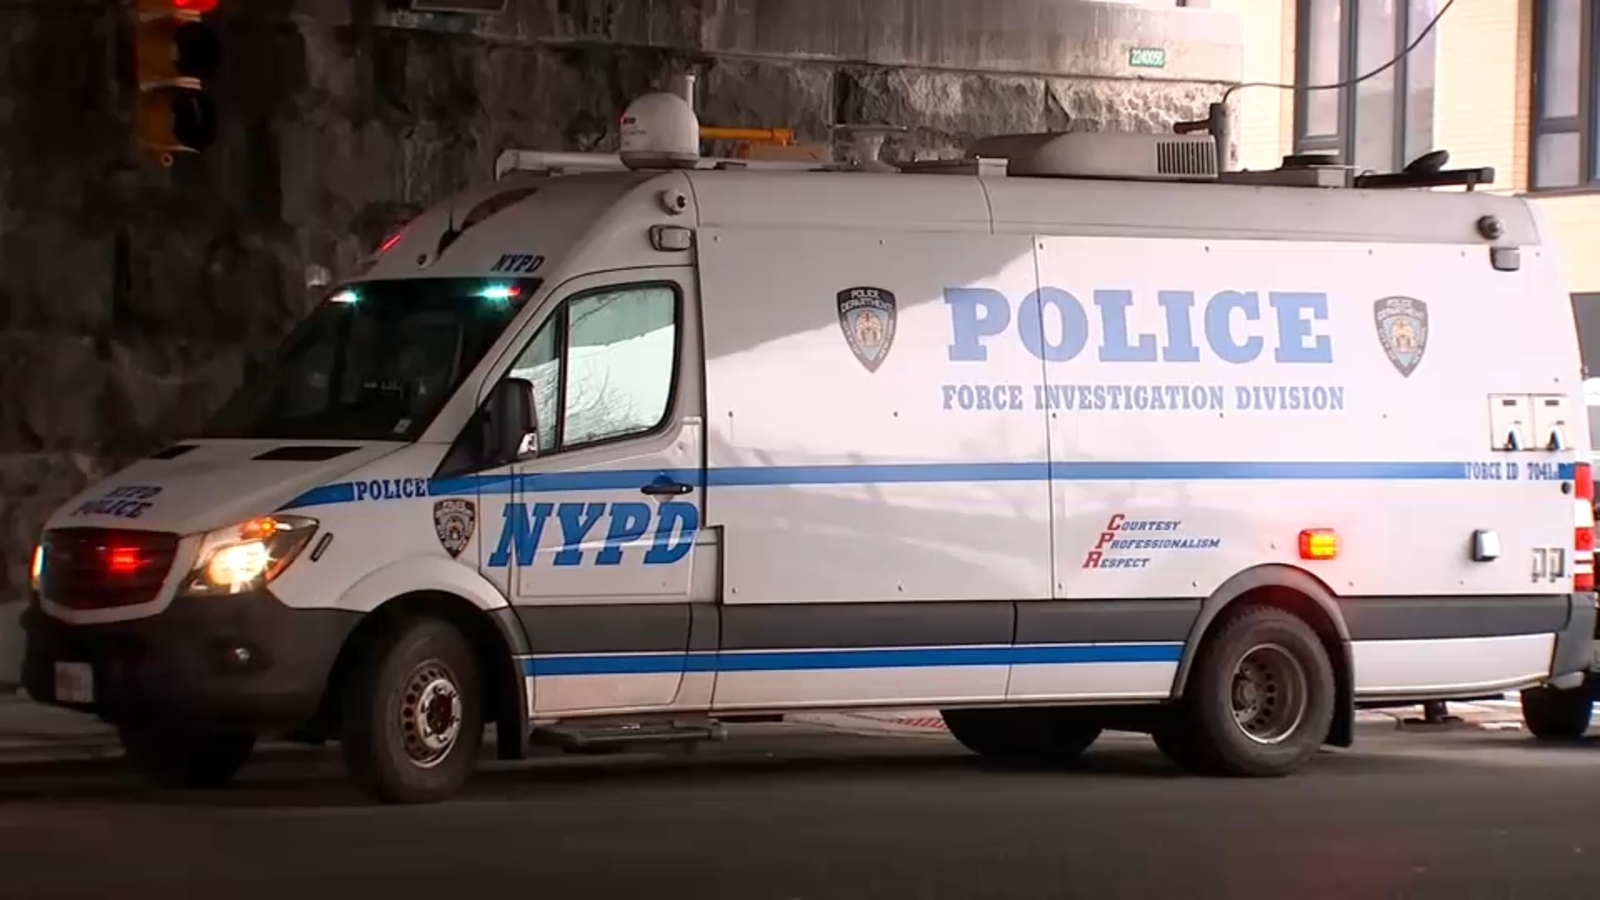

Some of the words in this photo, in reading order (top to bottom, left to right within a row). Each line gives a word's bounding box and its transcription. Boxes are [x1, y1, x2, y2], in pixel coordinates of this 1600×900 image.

[490, 253, 546, 273] NYPD
[943, 286, 1334, 364] POLICE
[942, 384, 1024, 411] FORCE
[1033, 384, 1225, 411] INVESTIGATION
[1235, 386, 1345, 411] DIVISION
[1465, 461, 1501, 480] FORCE
[1506, 462, 1518, 480] ID
[355, 477, 426, 501] POLICE
[487, 502, 699, 567] NYPD
